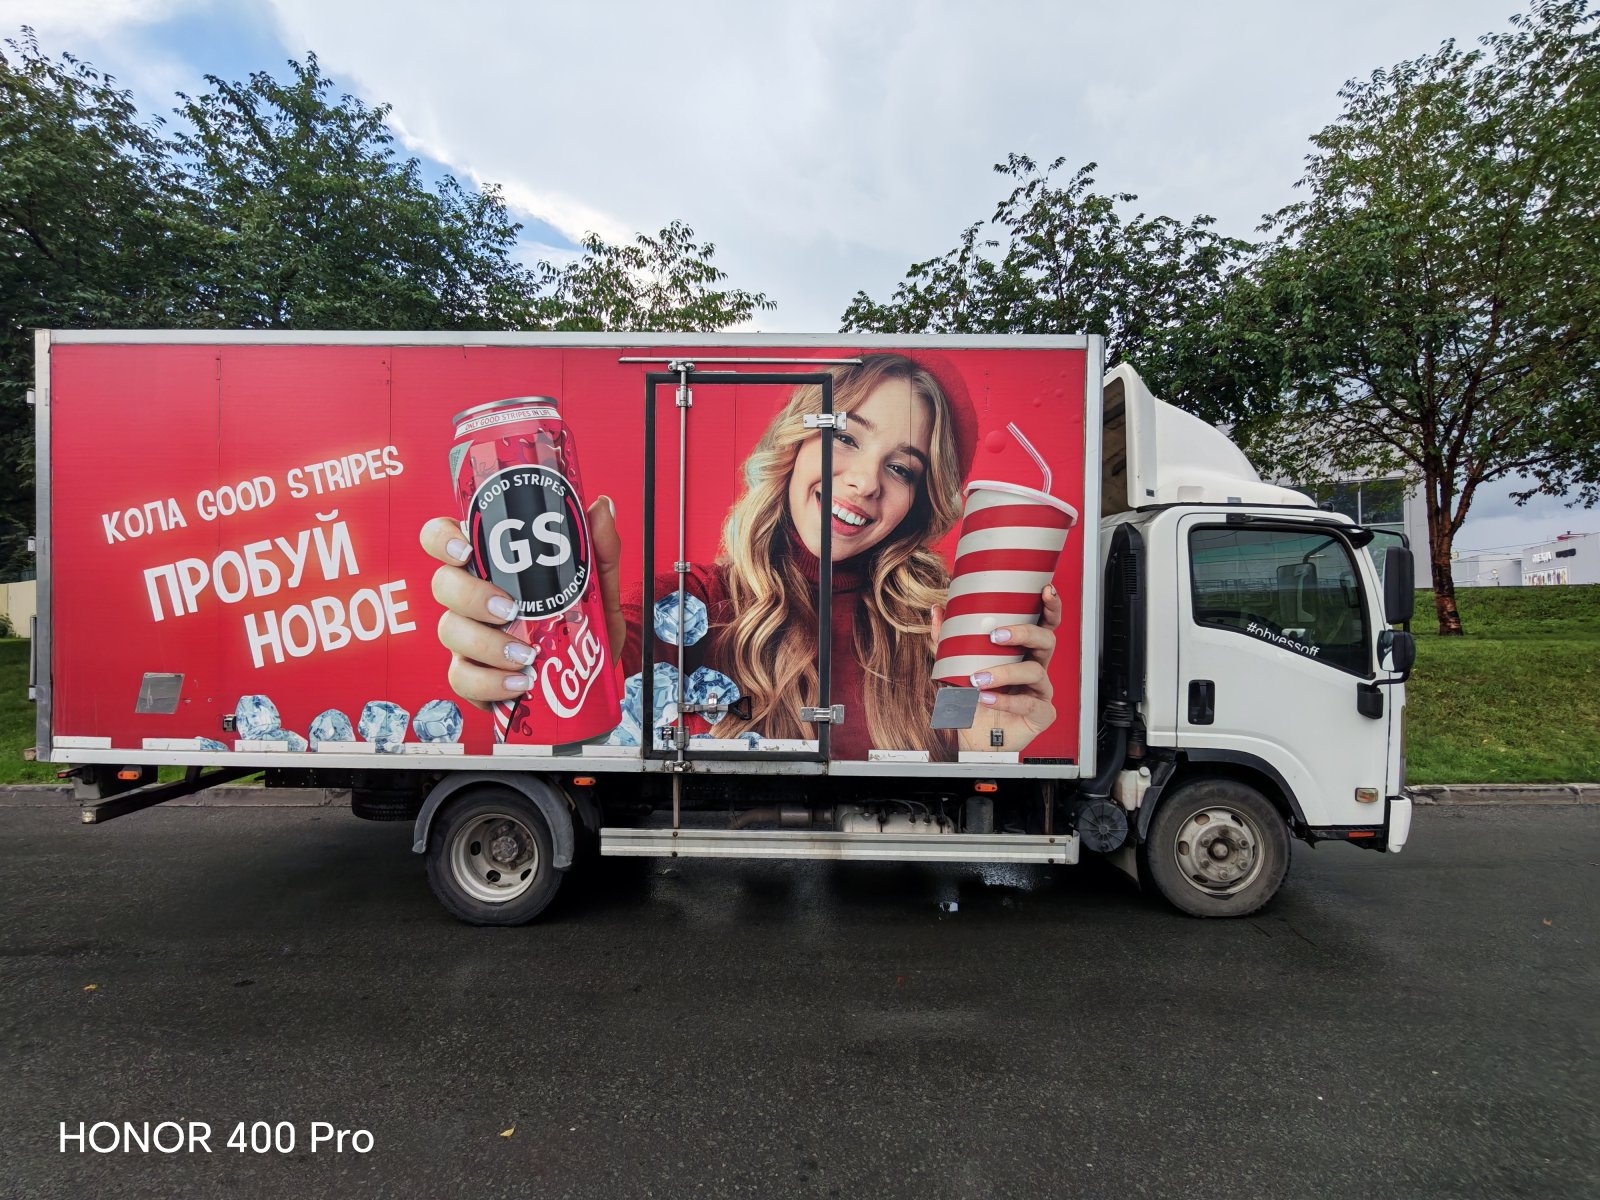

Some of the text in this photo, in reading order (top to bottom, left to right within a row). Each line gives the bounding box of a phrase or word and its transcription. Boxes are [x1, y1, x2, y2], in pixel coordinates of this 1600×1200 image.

[480, 416, 500, 426] GOOD
[502, 411, 531, 421] STRIPES
[102, 498, 187, 544] КОЛА
[197, 476, 276, 521] GOOD
[287, 446, 404, 499] STRIPES
[478, 474, 566, 510] GOOD STRIPES
[143, 508, 360, 622] ПРОБУЙ
[489, 512, 571, 574] GS
[243, 579, 417, 669] НОВОЕ
[514, 565, 586, 612] ШИЕ ПОЛОСЫ
[541, 614, 604, 719] Cola
